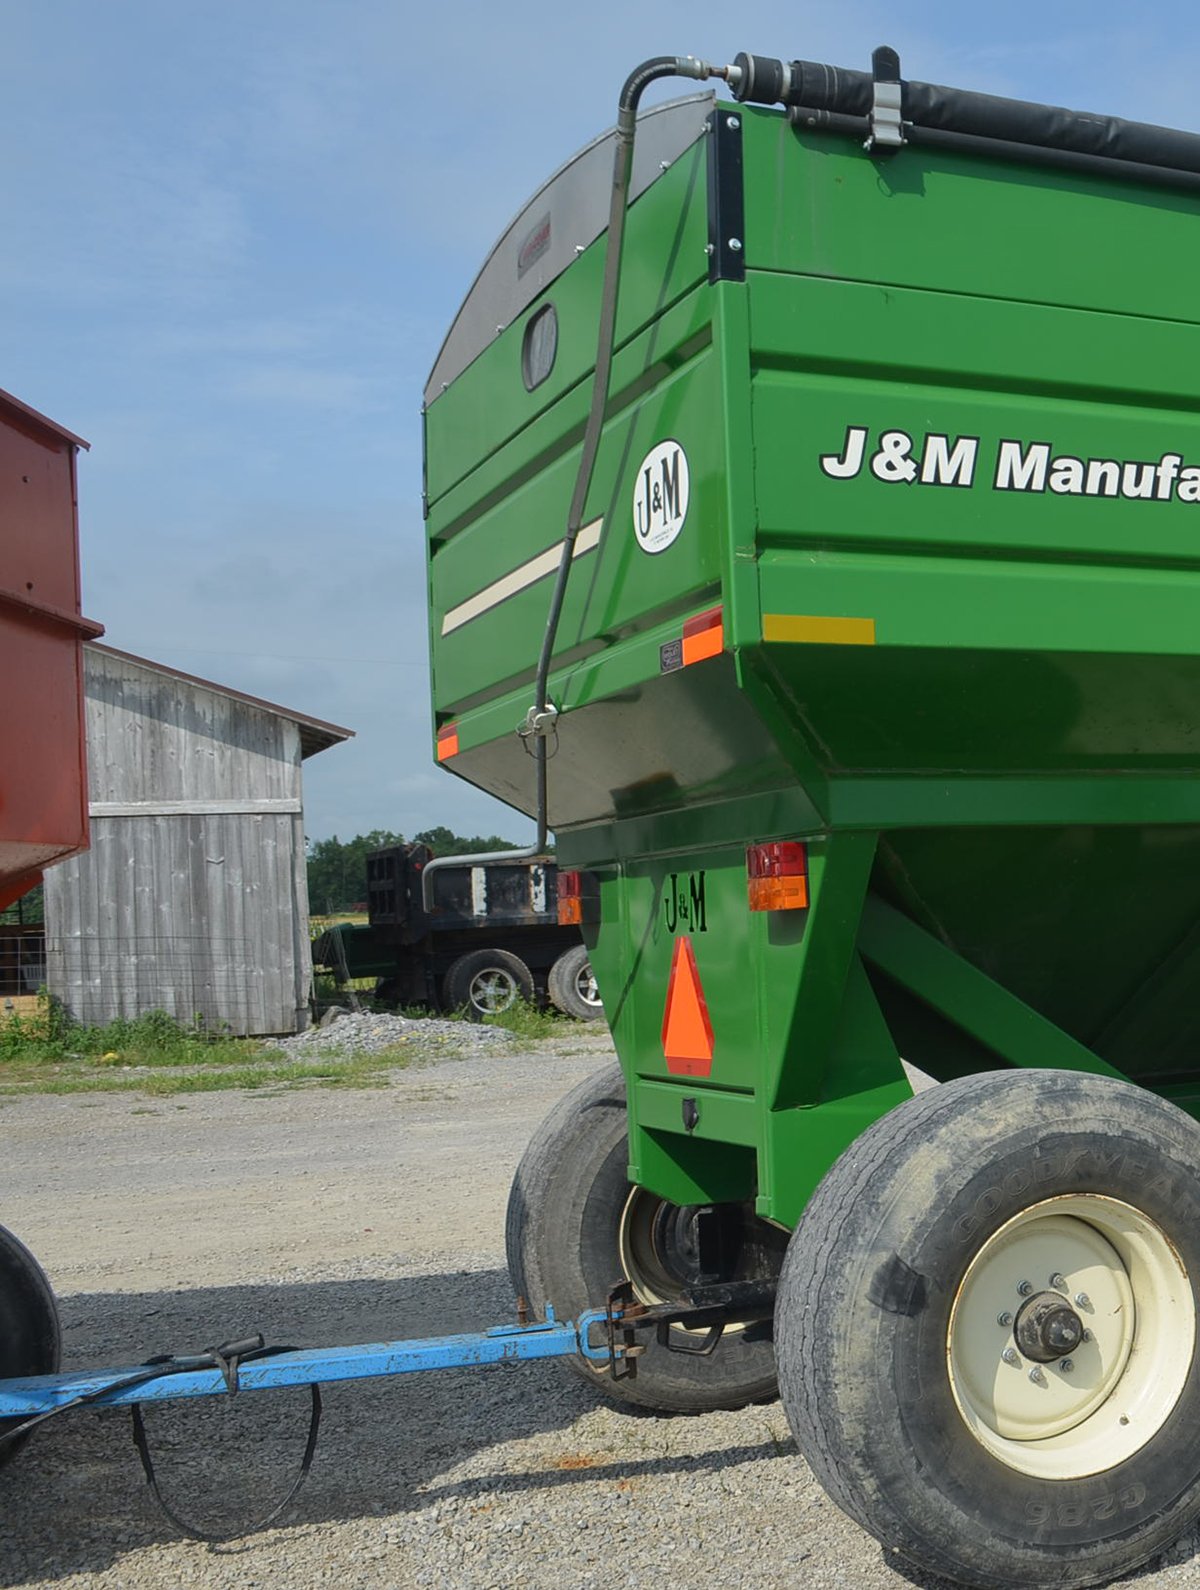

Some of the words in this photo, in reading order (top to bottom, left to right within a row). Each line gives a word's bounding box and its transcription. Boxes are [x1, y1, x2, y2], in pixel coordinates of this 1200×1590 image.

[820, 426, 980, 487] J&M
[637, 449, 681, 537] J&M
[664, 871, 707, 933] J&M
